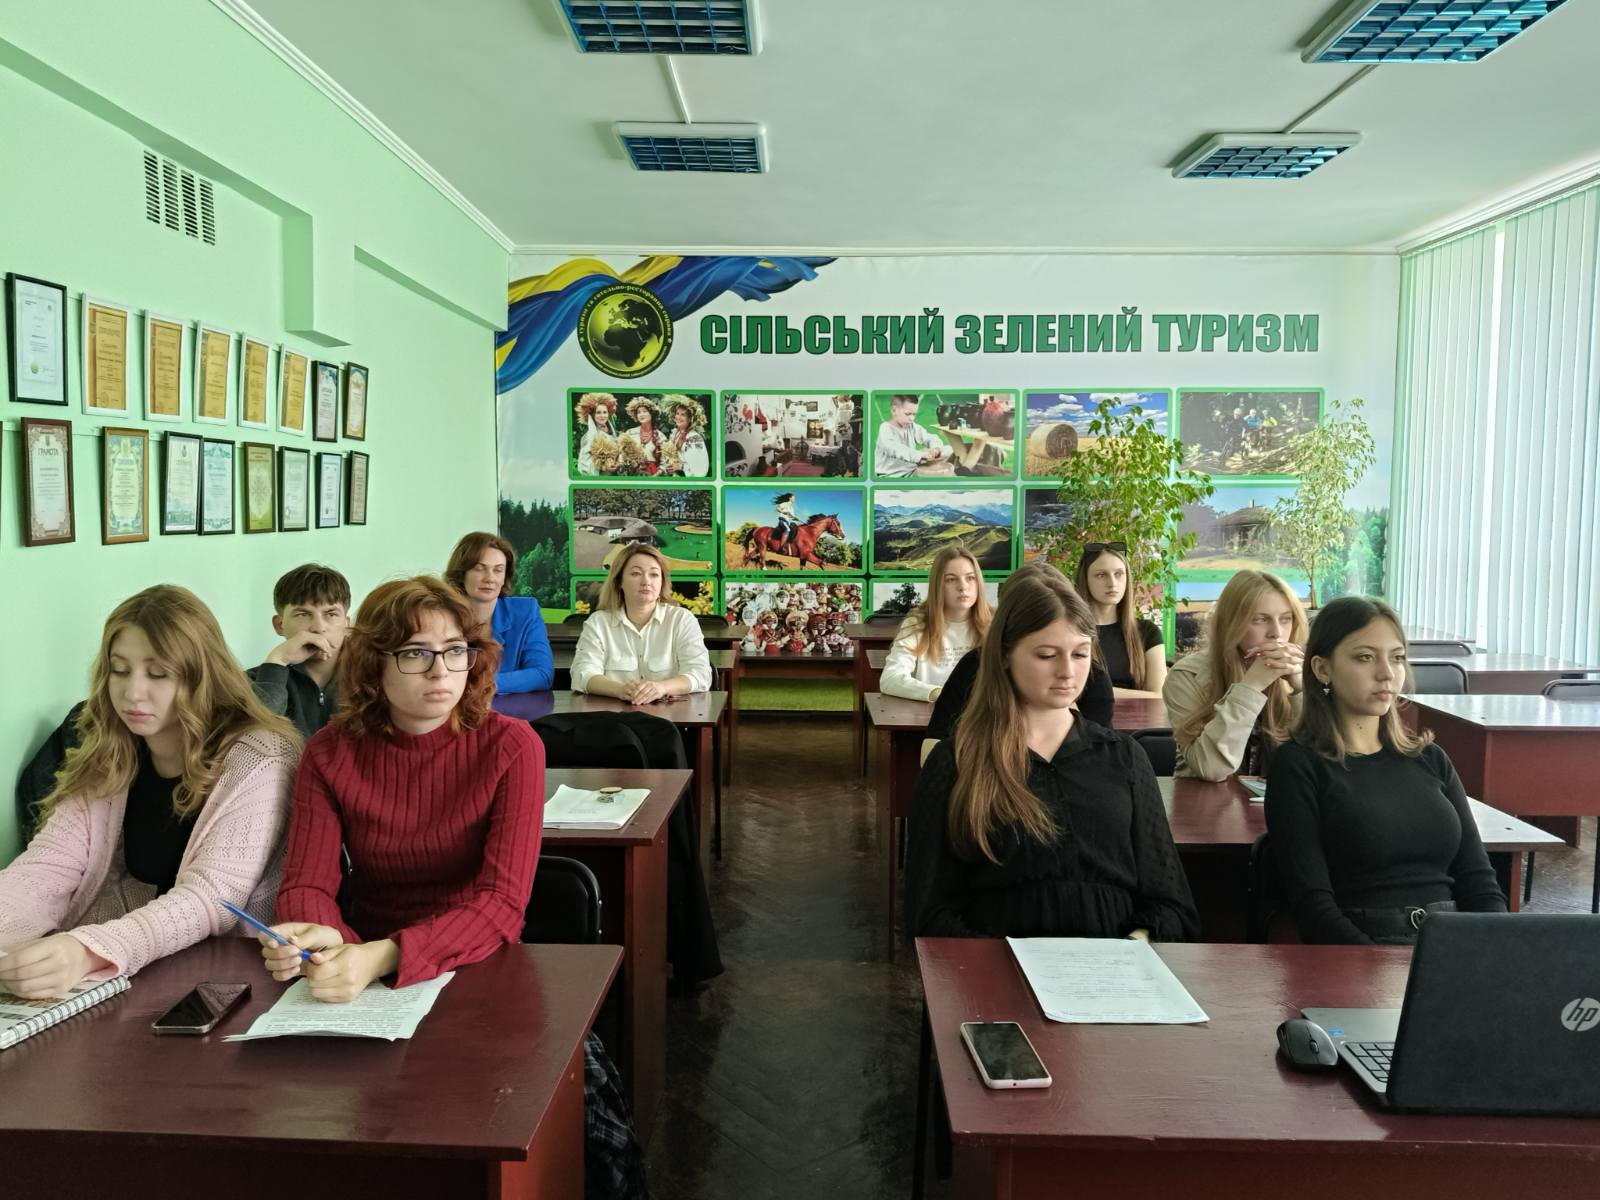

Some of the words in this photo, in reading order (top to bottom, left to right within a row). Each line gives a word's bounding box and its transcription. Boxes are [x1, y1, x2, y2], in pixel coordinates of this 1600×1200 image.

[700, 307, 944, 355] СІЛЬСЬКИЙ
[954, 306, 1142, 354] ЗЕЛЕНИЙ
[1152, 313, 1320, 353] ТУРИЗМ
[1564, 997, 1600, 1031] hp
